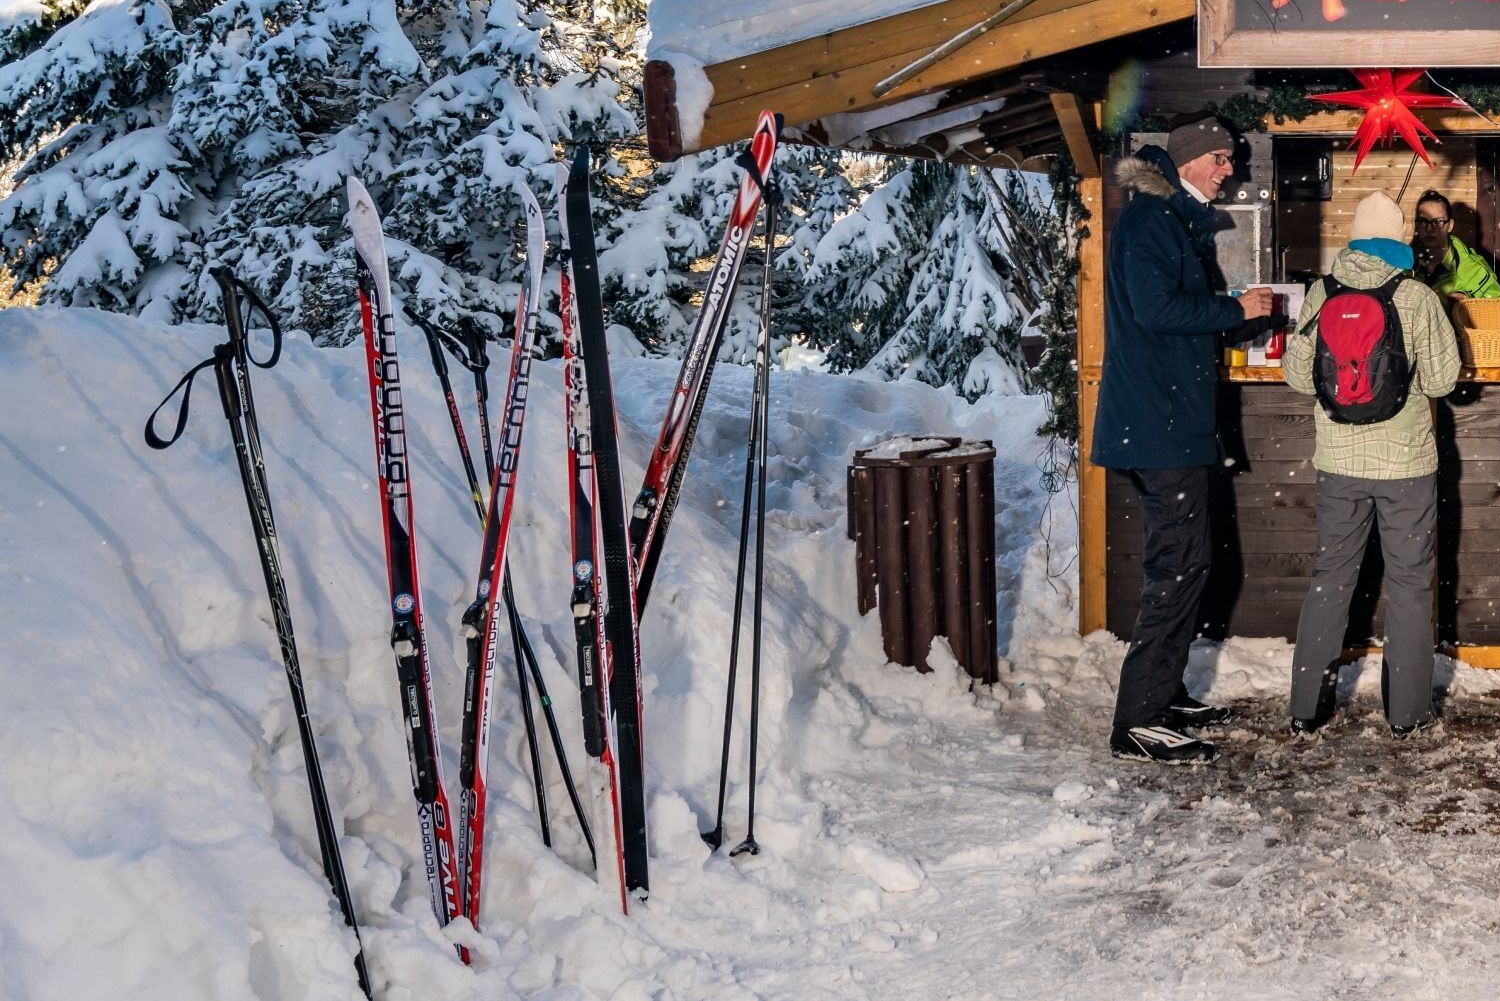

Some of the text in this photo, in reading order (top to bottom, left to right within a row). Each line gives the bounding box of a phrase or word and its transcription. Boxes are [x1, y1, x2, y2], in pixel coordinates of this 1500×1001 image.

[708, 225, 744, 312] ATOMIC
[370, 289, 381, 353] GRIP
[373, 356, 383, 380] 8
[433, 801, 447, 831] 8
